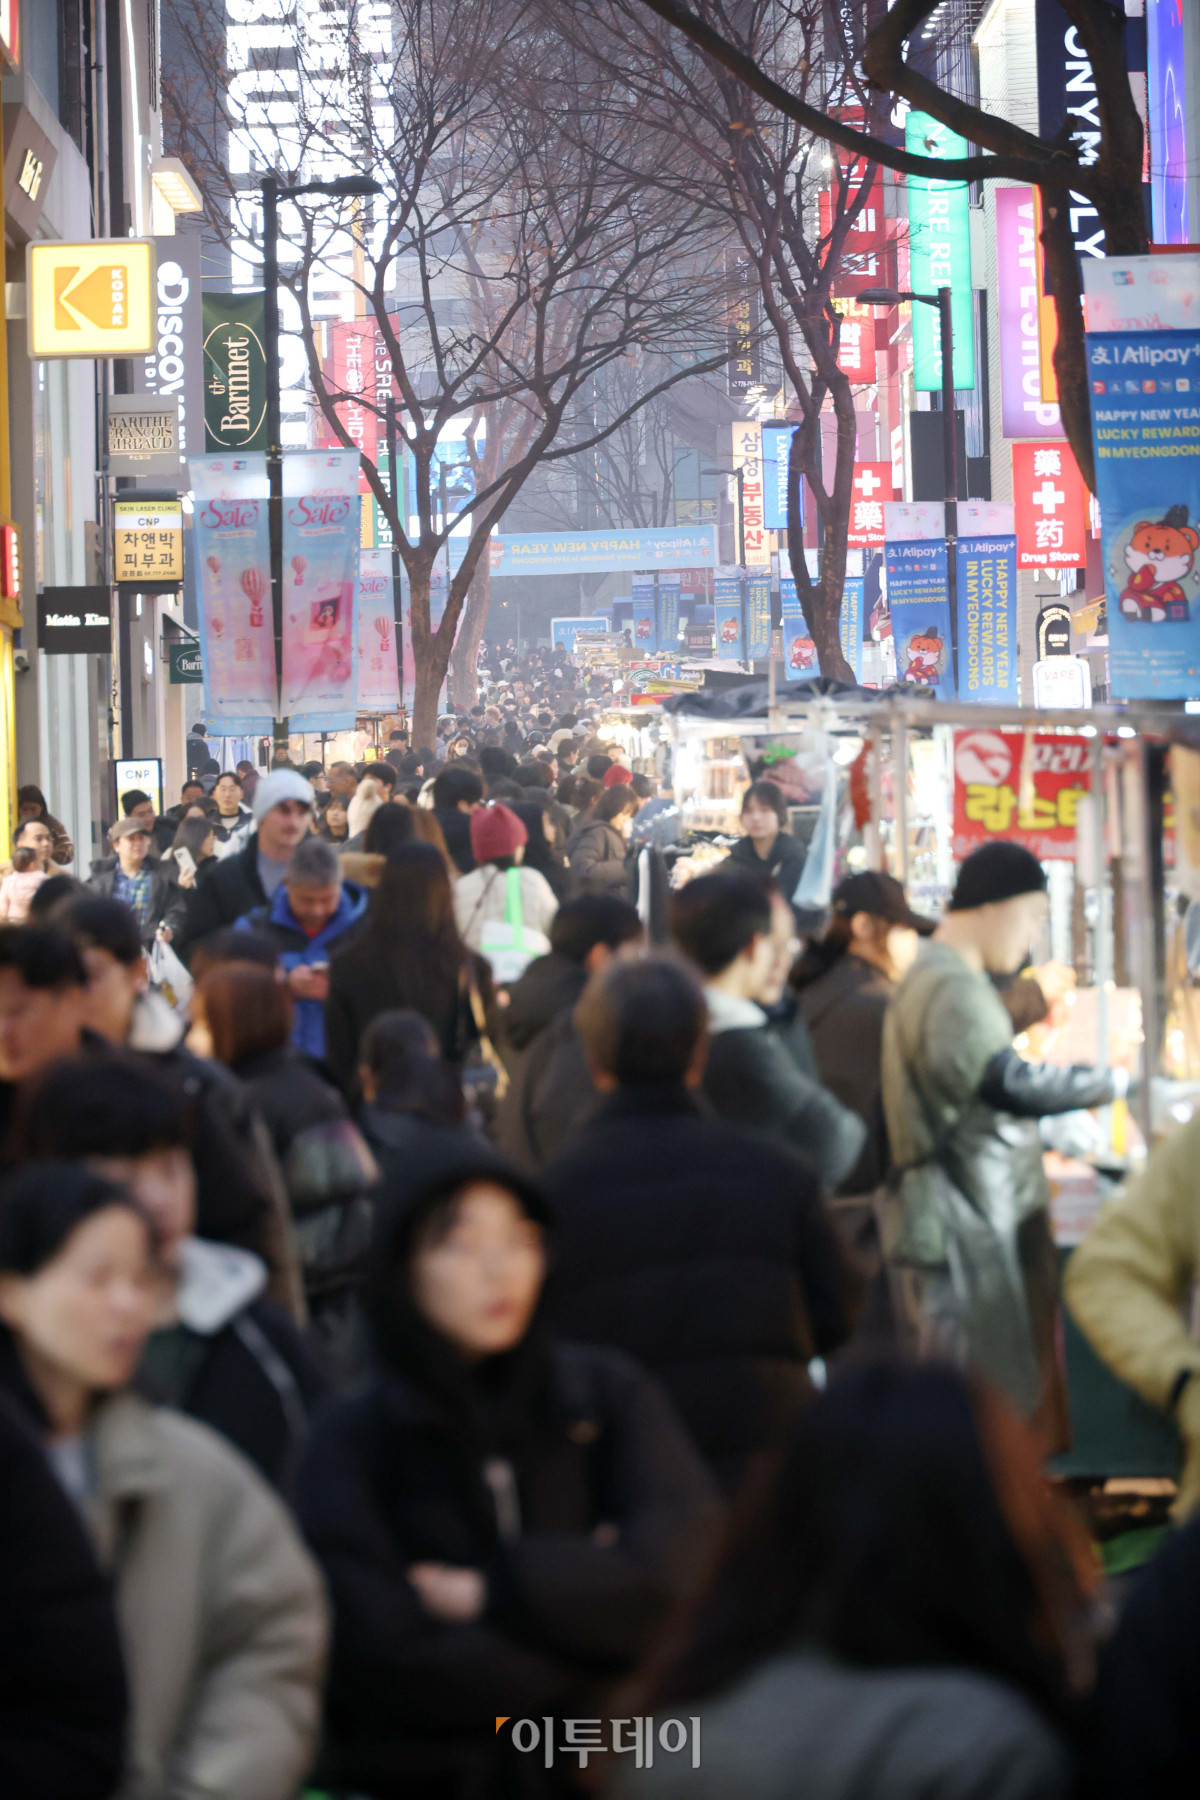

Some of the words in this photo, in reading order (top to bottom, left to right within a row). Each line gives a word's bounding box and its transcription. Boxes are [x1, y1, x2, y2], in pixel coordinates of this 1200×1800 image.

[926, 121, 950, 233] NAURE
[111, 268, 124, 326] KODAK
[220, 336, 250, 432] Barnnet
[1095, 410, 1138, 422] HAPPY
[1140, 409, 1170, 421] NEW
[1173, 407, 1200, 420] YEA
[1097, 428, 1139, 441] LUCKY
[740, 432, 761, 477] 삼성
[1034, 449, 1062, 476] 藥
[1098, 447, 1111, 458] IN
[137, 518, 160, 527] CNP
[200, 497, 259, 529] Sale
[287, 494, 350, 527] Sale
[742, 482, 764, 550] 부동산
[853, 500, 883, 531] 藥
[123, 532, 175, 550] 차앤박
[847, 534, 867, 543] Drug
[975, 541, 1016, 553] Alipay+
[1035, 518, 1064, 549] 药
[123, 552, 175, 569] 피부과
[902, 546, 944, 559] Alipay+
[1021, 553, 1048, 564] Drug
[1048, 551, 1080, 562] Store
[966, 561, 979, 577] IN
[981, 559, 993, 609] LUCKY
[995, 558, 1008, 609] HAPPY
[850, 591, 858, 622] HAPPY
[849, 624, 857, 647] NEW
[966, 578, 980, 691] MYEONGDONG
[996, 611, 1008, 648] NEW
[981, 611, 994, 686] REWARDS
[996, 650, 1009, 689] YEAR
[1044, 669, 1076, 681] VAPE
[125, 769, 151, 780] CNP
